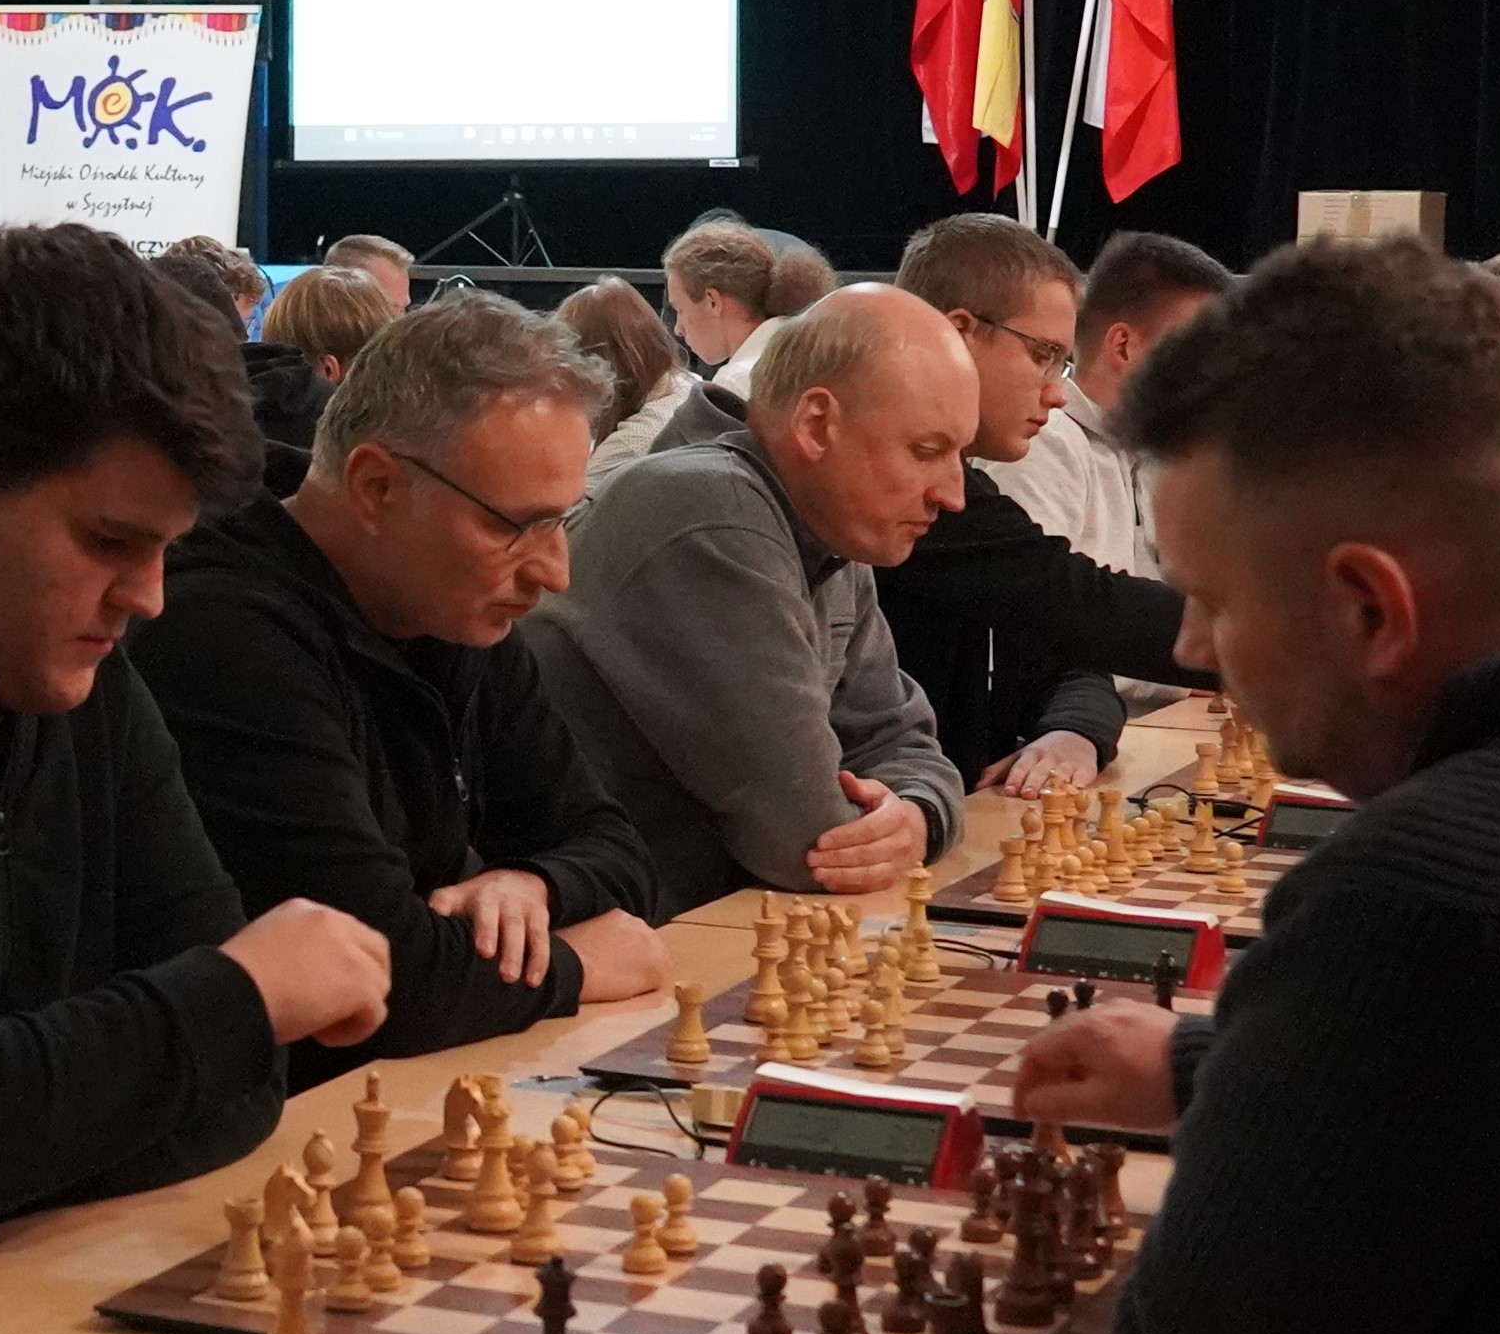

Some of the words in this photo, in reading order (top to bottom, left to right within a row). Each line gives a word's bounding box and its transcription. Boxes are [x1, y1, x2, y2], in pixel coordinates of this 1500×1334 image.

[20, 164, 74, 187] Miejski
[79, 163, 139, 181] Ośrodek
[144, 163, 205, 189] Kultury
[82, 192, 154, 217] Szczytnej
